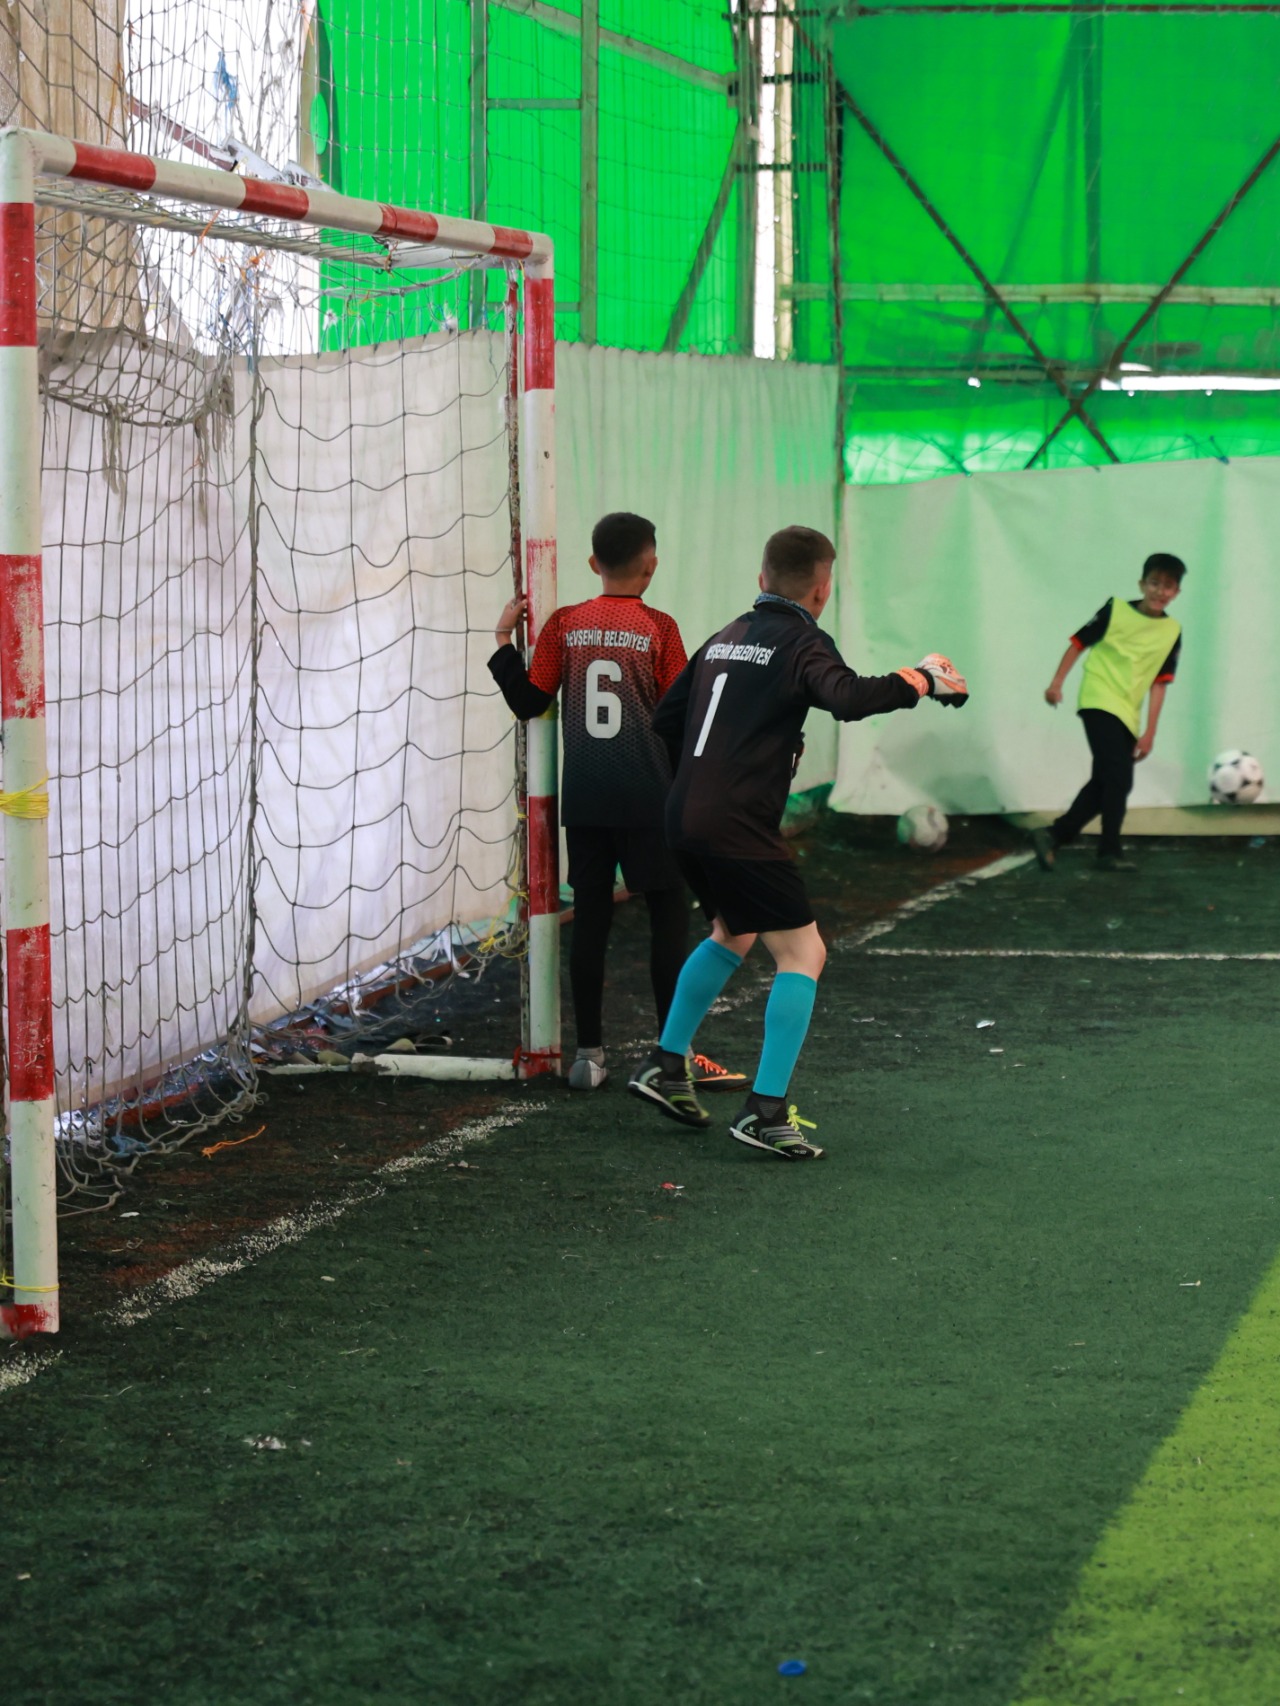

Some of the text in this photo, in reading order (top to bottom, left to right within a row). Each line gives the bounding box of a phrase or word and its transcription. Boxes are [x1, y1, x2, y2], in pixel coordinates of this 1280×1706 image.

[603, 629, 652, 653] BELEDİYESİ
[585, 659, 622, 739] 6
[693, 671, 728, 757] 1
